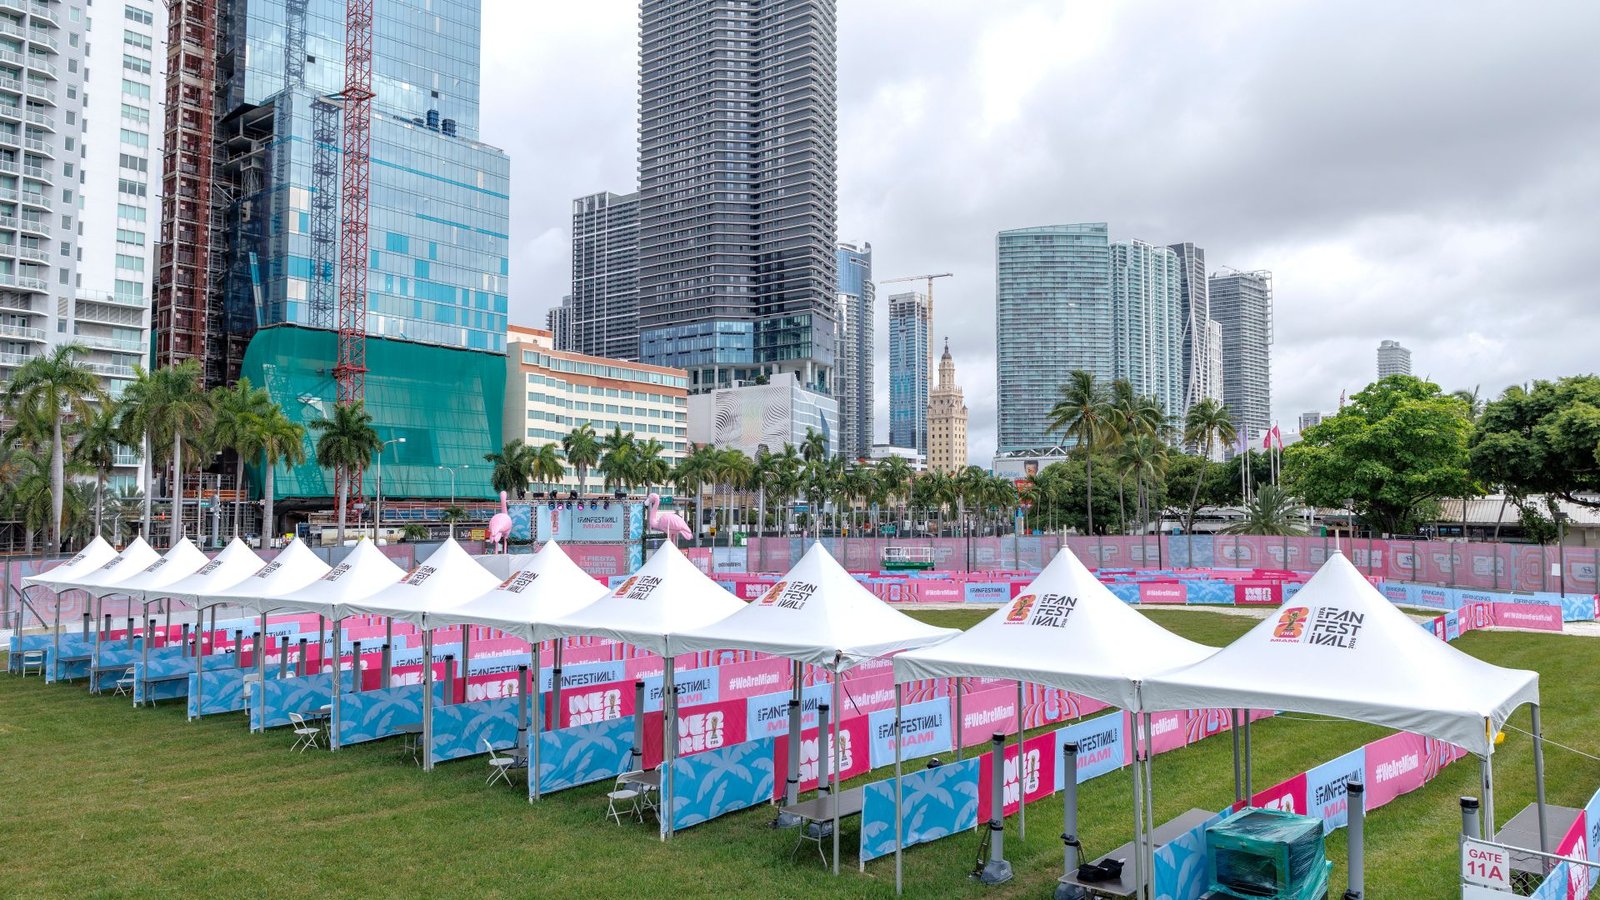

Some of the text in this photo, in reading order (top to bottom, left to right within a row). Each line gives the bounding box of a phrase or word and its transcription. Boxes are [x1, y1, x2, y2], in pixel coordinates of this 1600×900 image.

[784, 589, 812, 602] FEST
[794, 581, 818, 593] FAN
[1047, 594, 1078, 607] FAN
[1036, 604, 1074, 616] FEST
[1325, 607, 1364, 624] FAN
[1314, 620, 1362, 637] FEST
[729, 672, 779, 691] #WeAreMiami
[964, 703, 1015, 729] #WeAreMiami
[1376, 750, 1419, 783] #WeAreMiami
[1468, 848, 1502, 864] GATE
[1467, 861, 1504, 881] 11A
